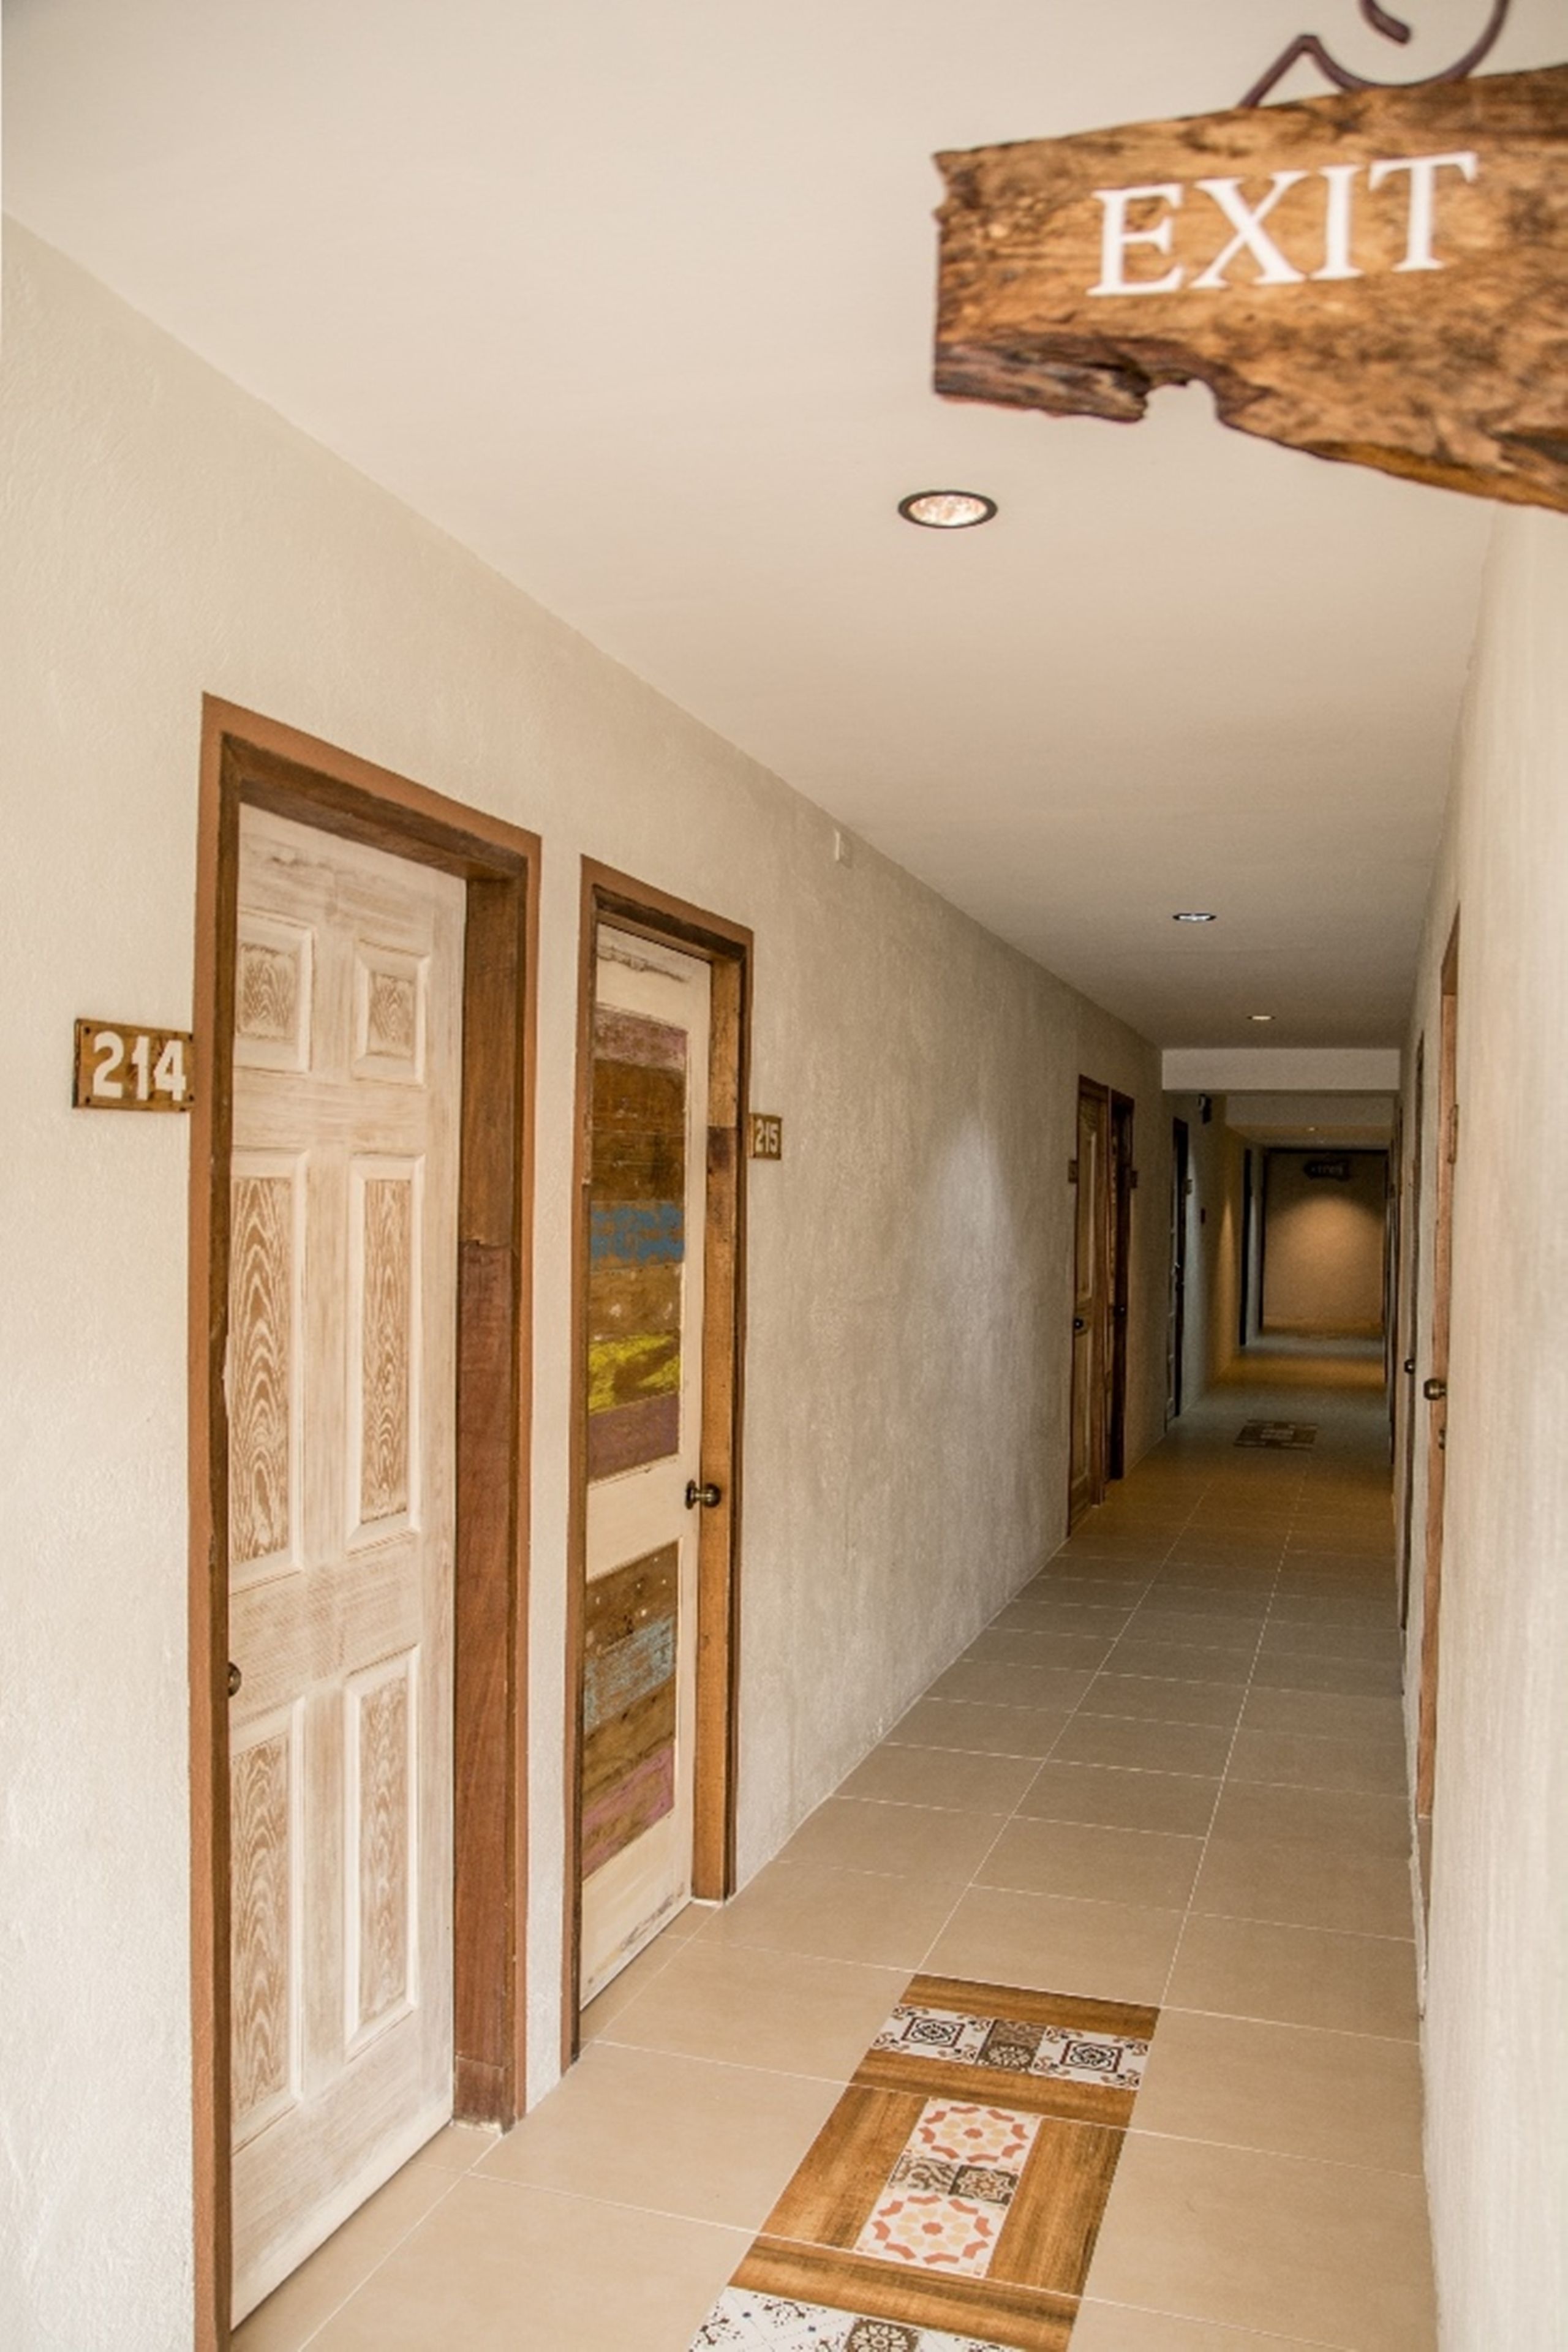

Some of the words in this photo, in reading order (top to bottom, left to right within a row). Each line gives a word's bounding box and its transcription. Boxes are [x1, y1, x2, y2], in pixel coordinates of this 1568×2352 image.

[1086, 151, 1478, 296] EXIT
[92, 1030, 186, 1101] 214
[755, 1118, 778, 1153] 215
